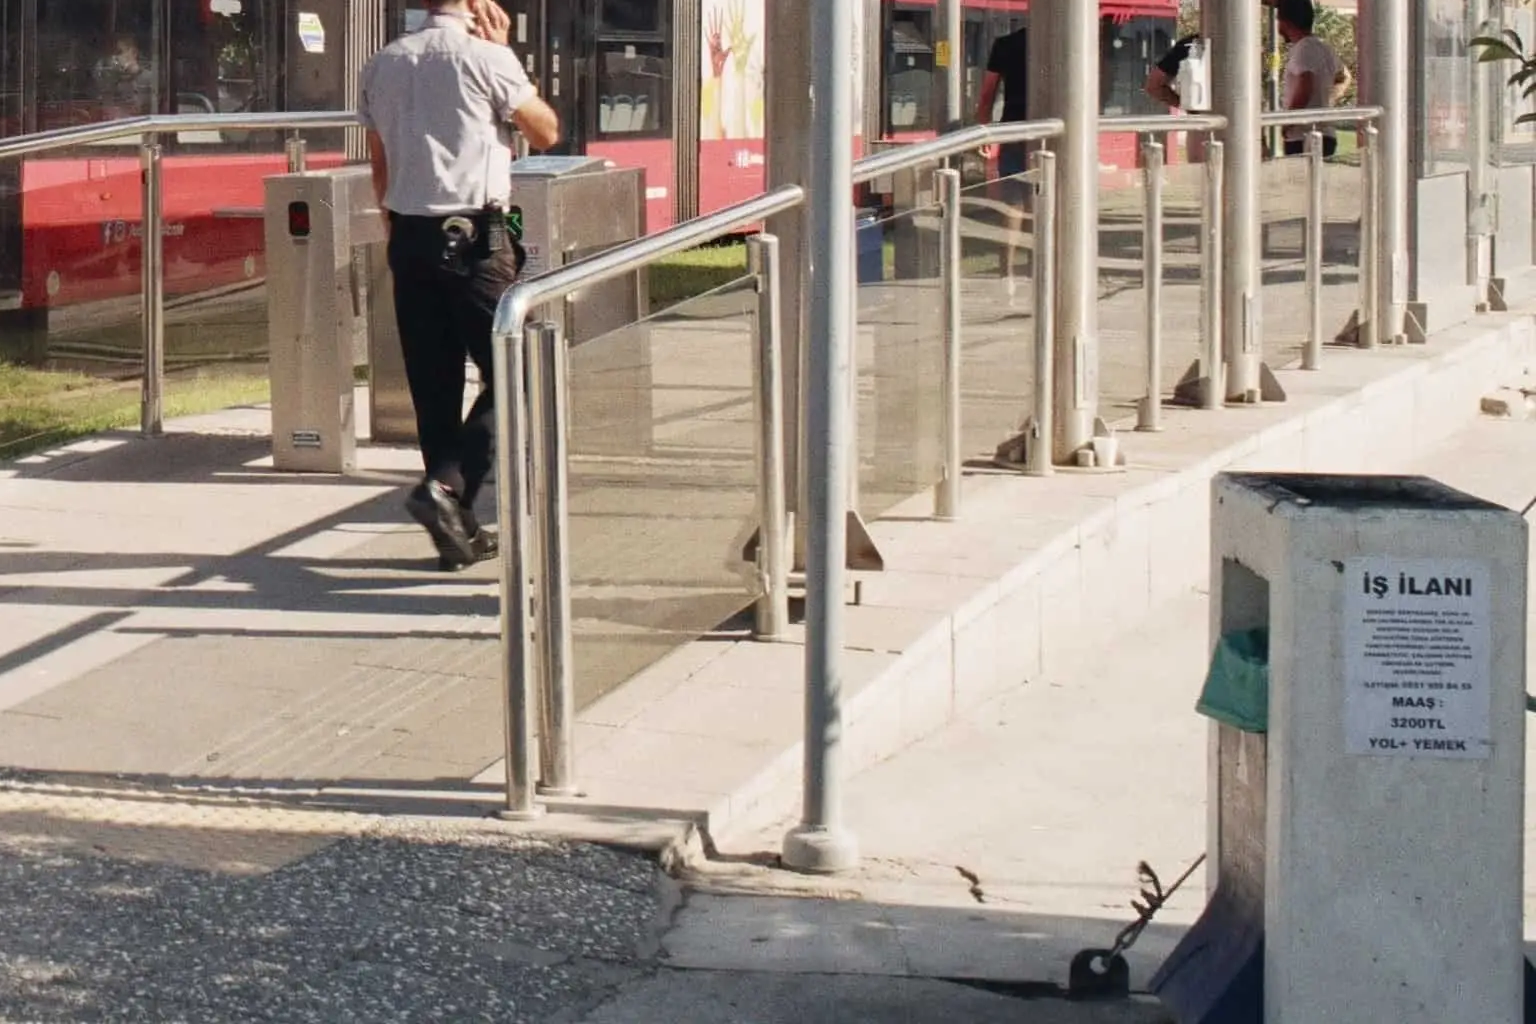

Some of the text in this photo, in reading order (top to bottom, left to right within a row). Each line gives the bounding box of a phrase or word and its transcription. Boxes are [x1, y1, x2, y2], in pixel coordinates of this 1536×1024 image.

[1363, 571, 1472, 599] İŞ İLANI
[1390, 717, 1446, 730] 3200TL
[1413, 739, 1467, 751] YEMEK
